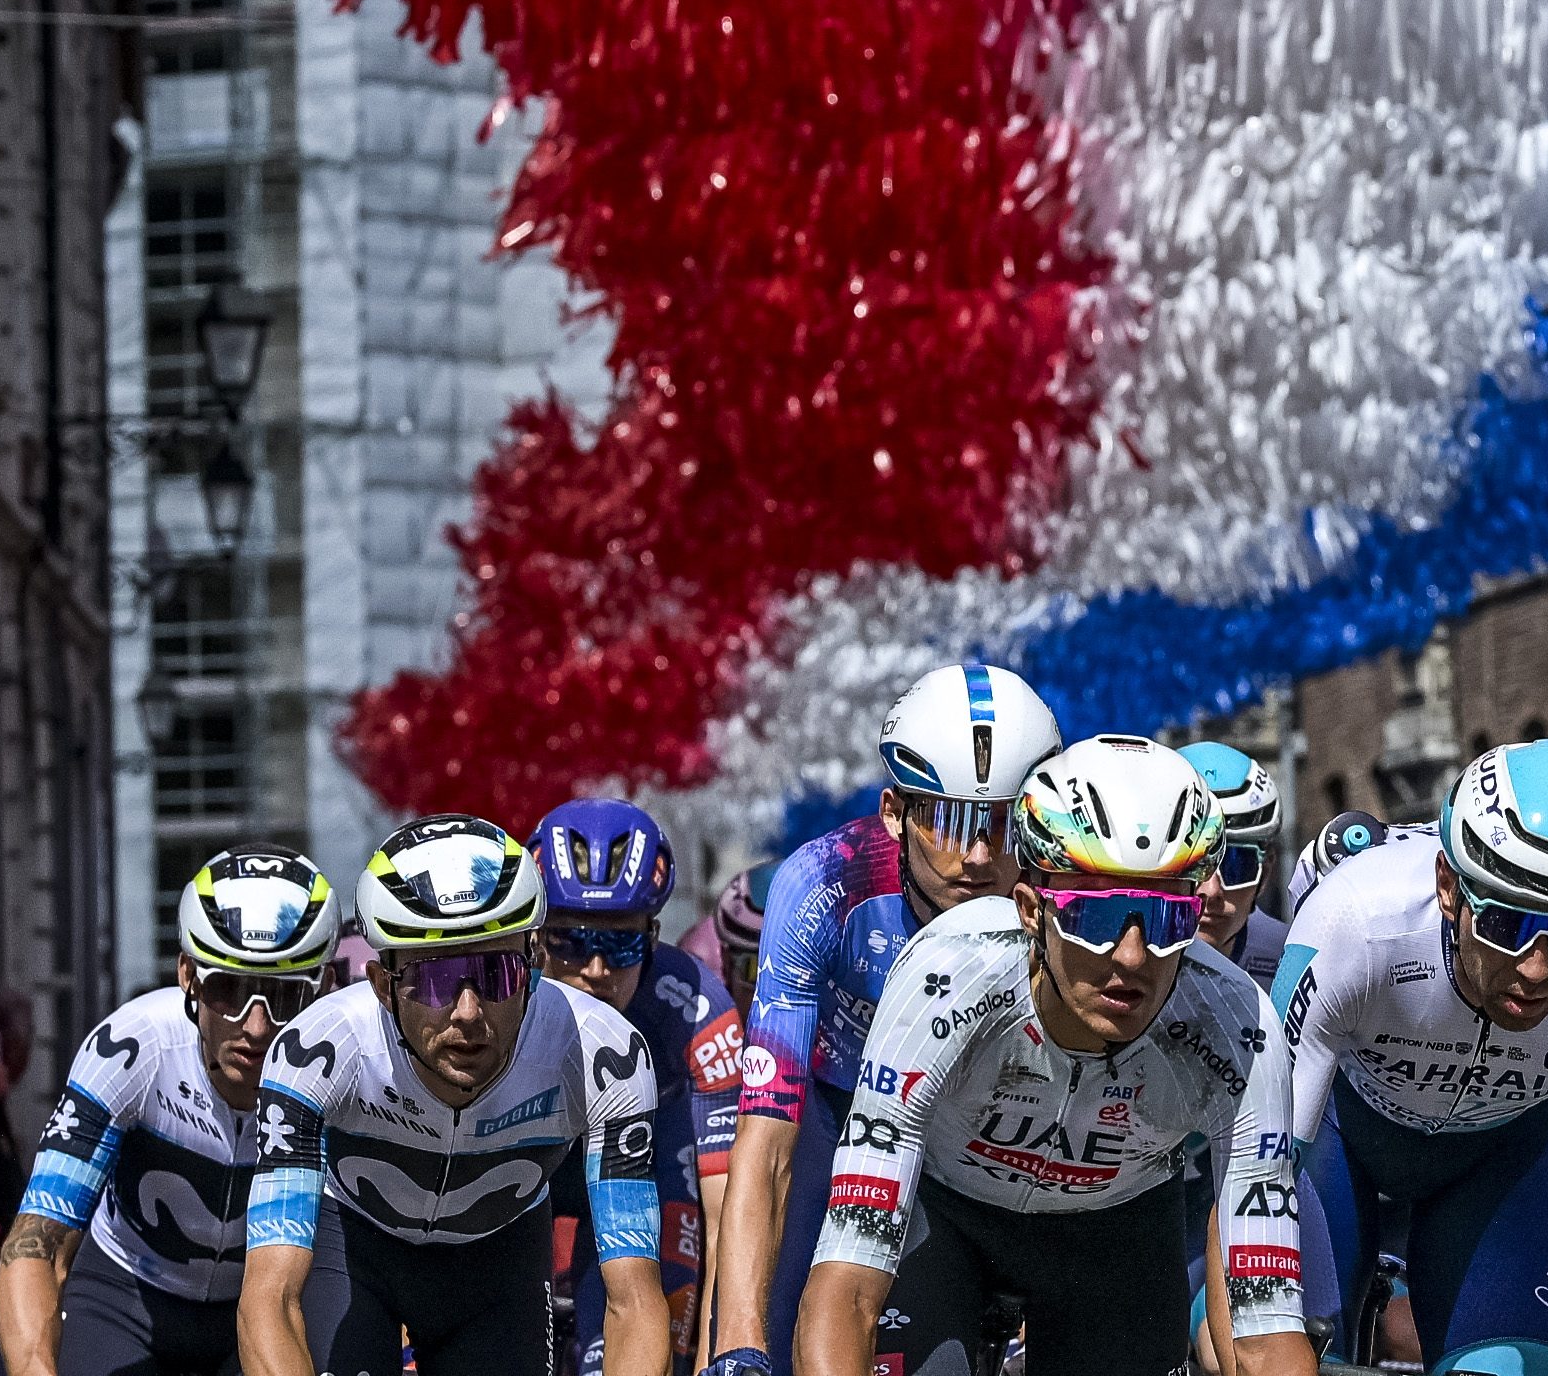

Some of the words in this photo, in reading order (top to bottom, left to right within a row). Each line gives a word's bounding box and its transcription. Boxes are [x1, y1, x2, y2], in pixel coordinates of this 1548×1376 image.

[1067, 777, 1100, 840] MET
[1184, 782, 1204, 848] MET
[950, 988, 1017, 1030] Analog
[1186, 1032, 1248, 1098] Analog
[156, 1090, 224, 1143] CANYON
[358, 1099, 442, 1140] CANYON
[483, 1098, 544, 1135] GOBIK
[1003, 1094, 1040, 1105] PISSEI
[978, 1112, 1126, 1166] UAE
[1257, 1132, 1294, 1161] FA
[983, 1144, 1104, 1186] Emirates
[1234, 1251, 1301, 1273] Emirates
